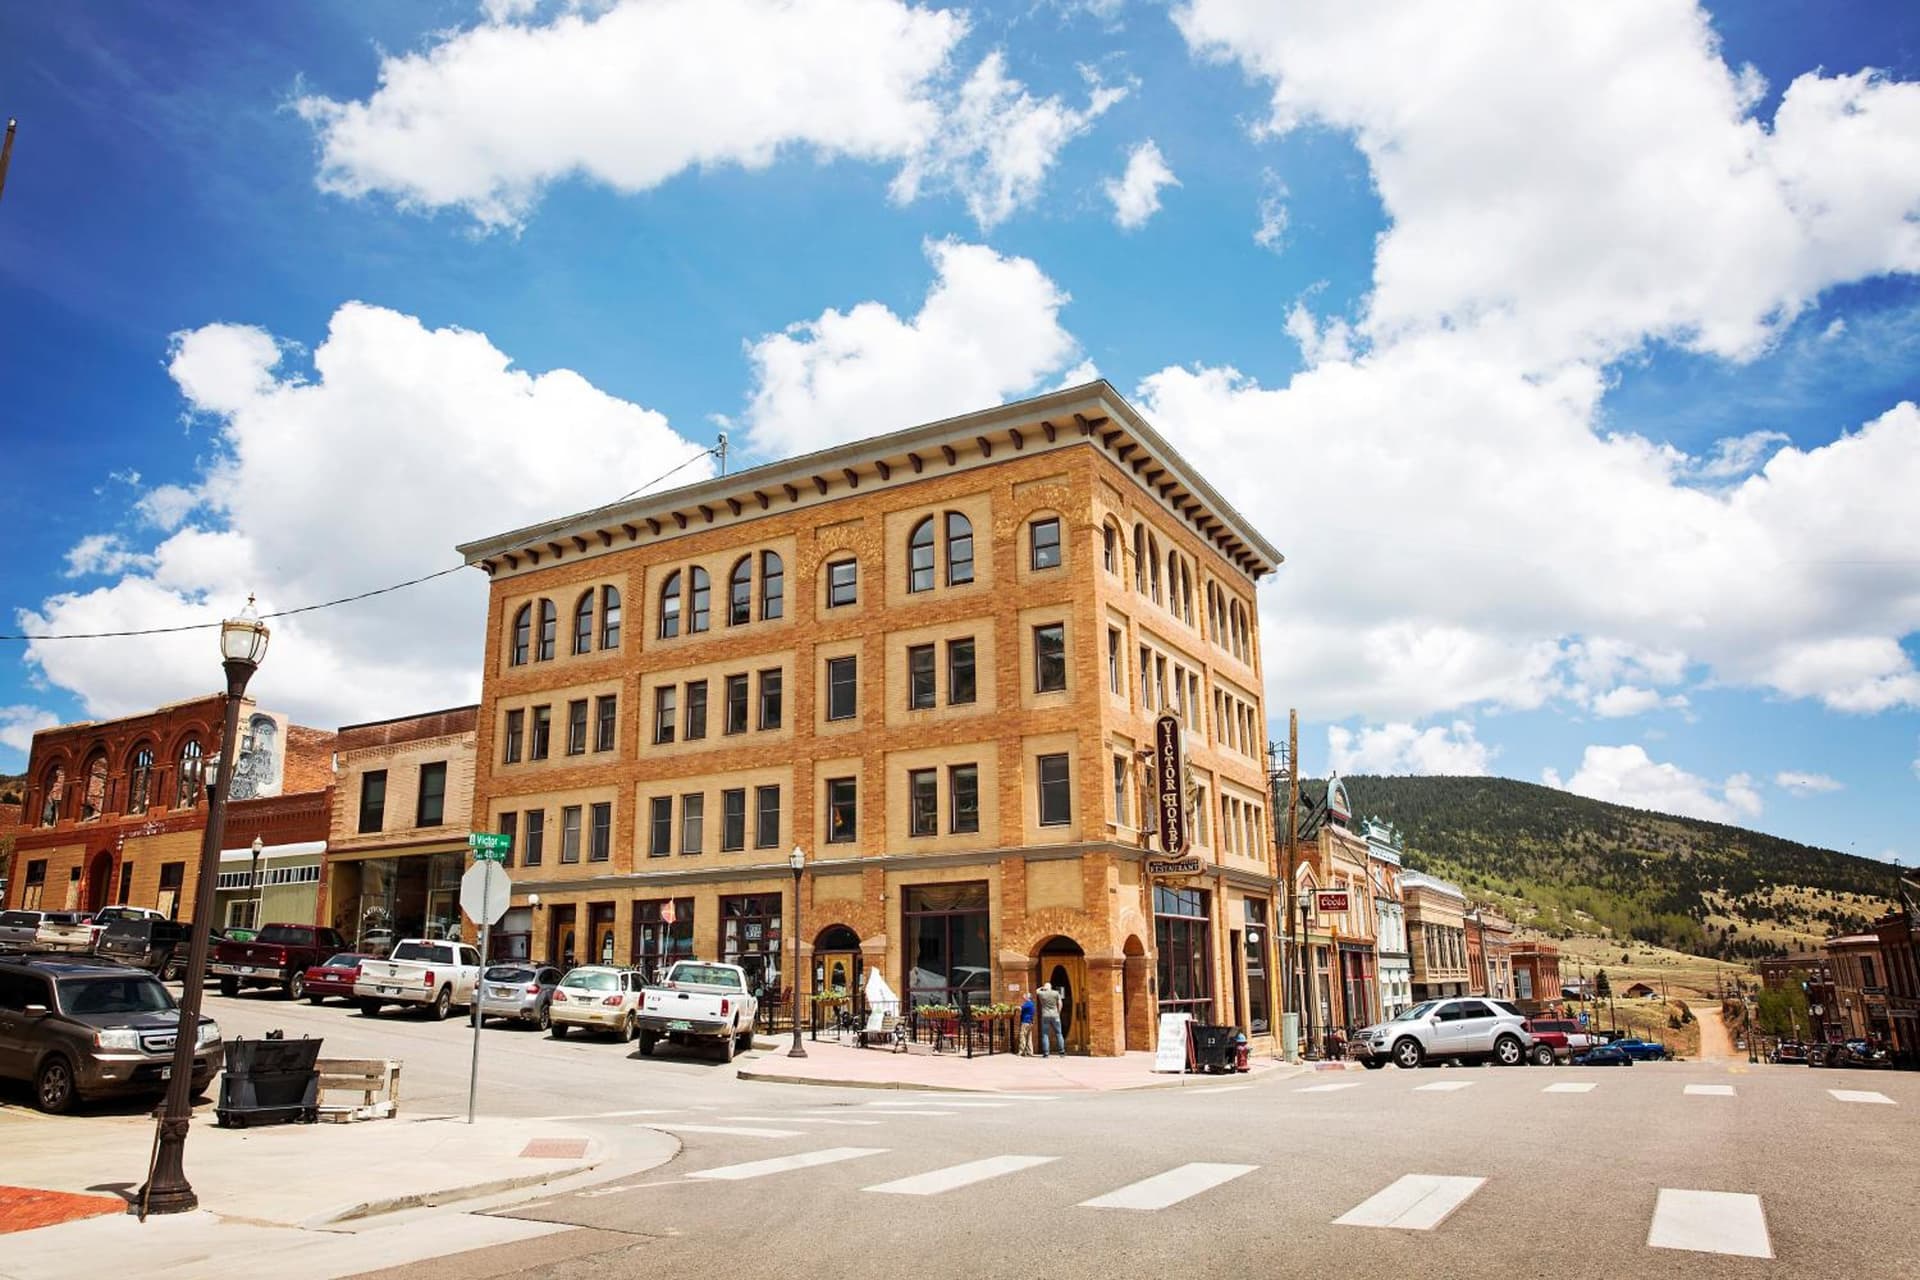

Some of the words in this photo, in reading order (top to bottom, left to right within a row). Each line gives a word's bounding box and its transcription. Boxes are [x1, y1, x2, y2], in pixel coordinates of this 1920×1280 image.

[1160, 720, 1176, 790] VICTOR
[476, 834, 498, 846] Victor
[1162, 793, 1178, 853] HOTEL
[1150, 863, 1199, 873] RESTAURANT
